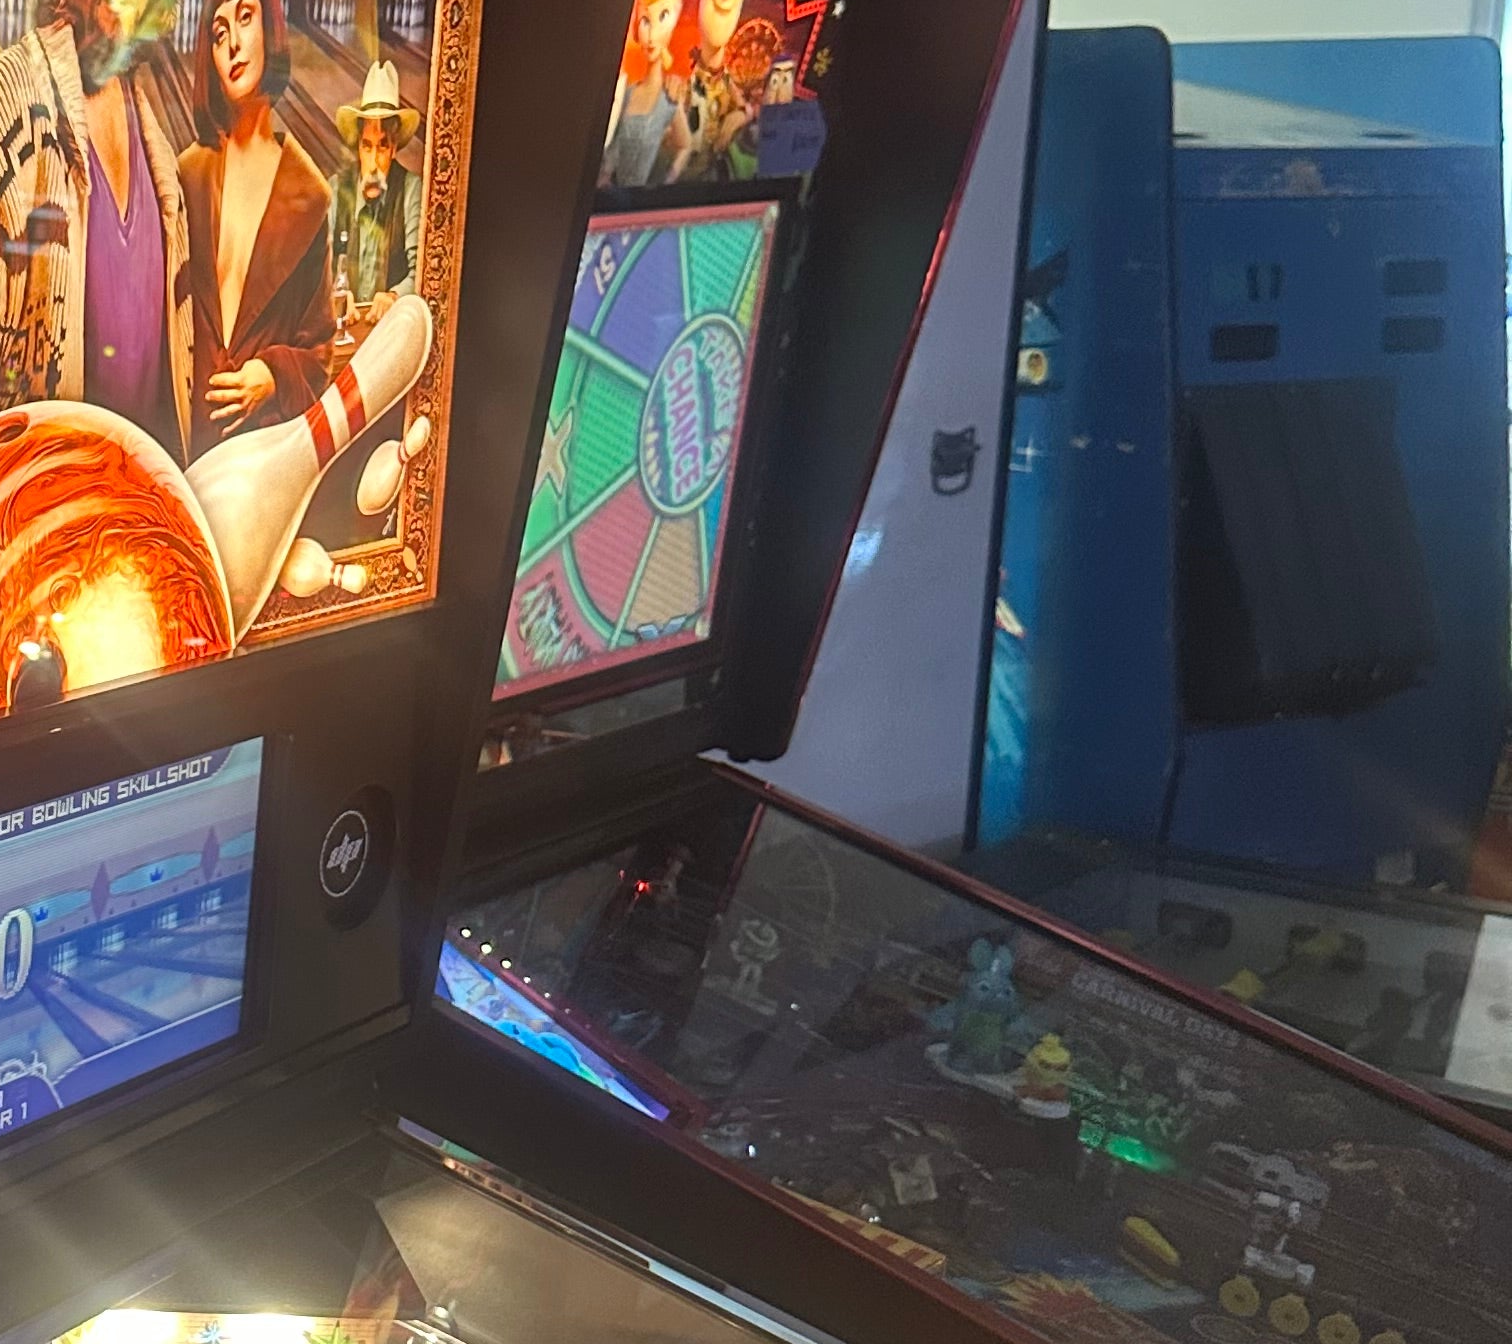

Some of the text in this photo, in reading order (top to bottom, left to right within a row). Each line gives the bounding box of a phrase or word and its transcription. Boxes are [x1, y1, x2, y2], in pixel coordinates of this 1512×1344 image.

[664, 343, 703, 502] CHANCE
[32, 785, 111, 826] BOWLING
[117, 755, 213, 801] SKILLSHOT
[20, 1101, 29, 1120] 1
